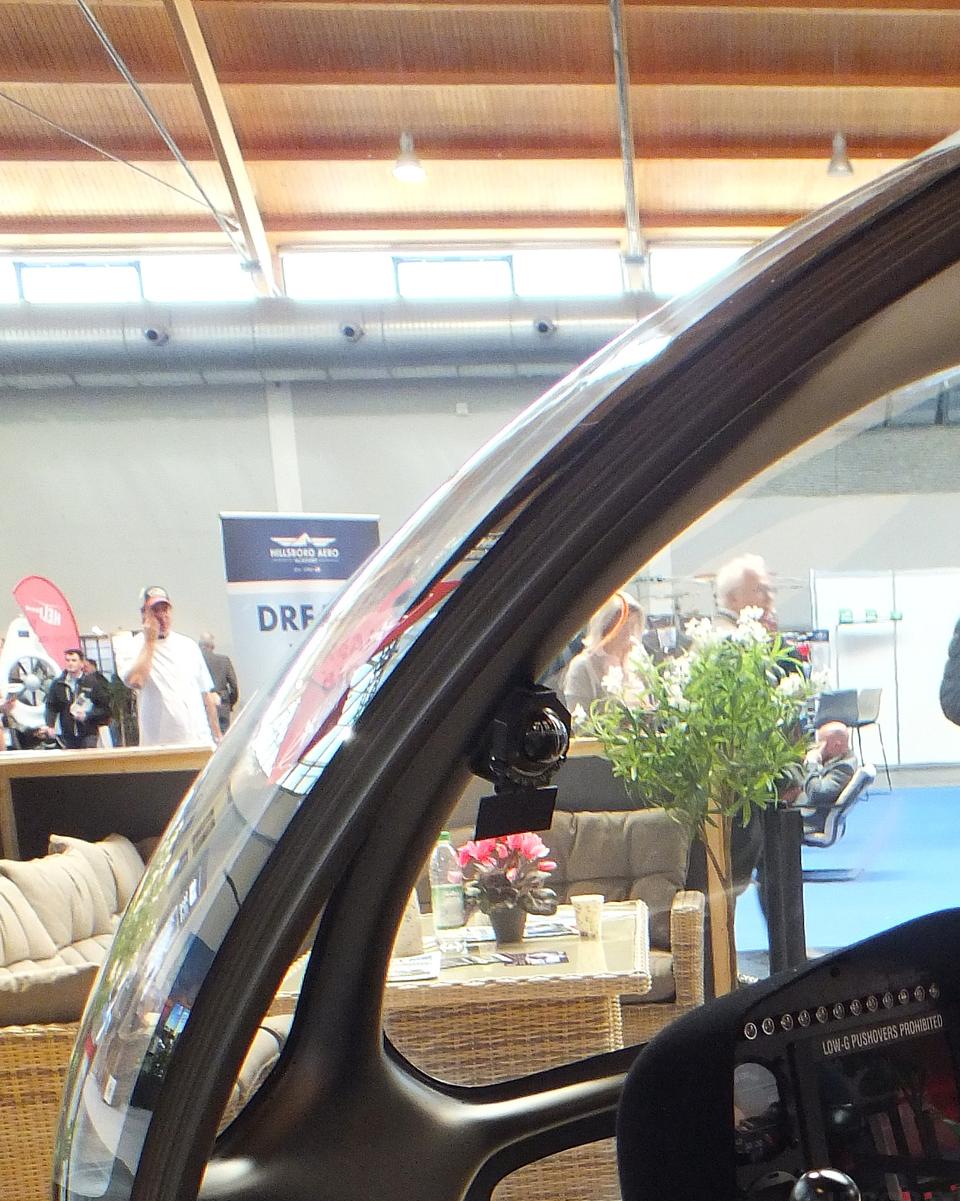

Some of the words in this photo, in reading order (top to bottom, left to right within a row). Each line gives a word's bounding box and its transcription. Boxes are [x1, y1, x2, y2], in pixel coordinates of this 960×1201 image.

[269, 548, 314, 558] HILLSBORO
[317, 548, 339, 558] AERO
[822, 1035, 851, 1056] LOW-G
[850, 1024, 899, 1049] PUSHOVERS
[899, 1014, 944, 1037] PROHIBITED
